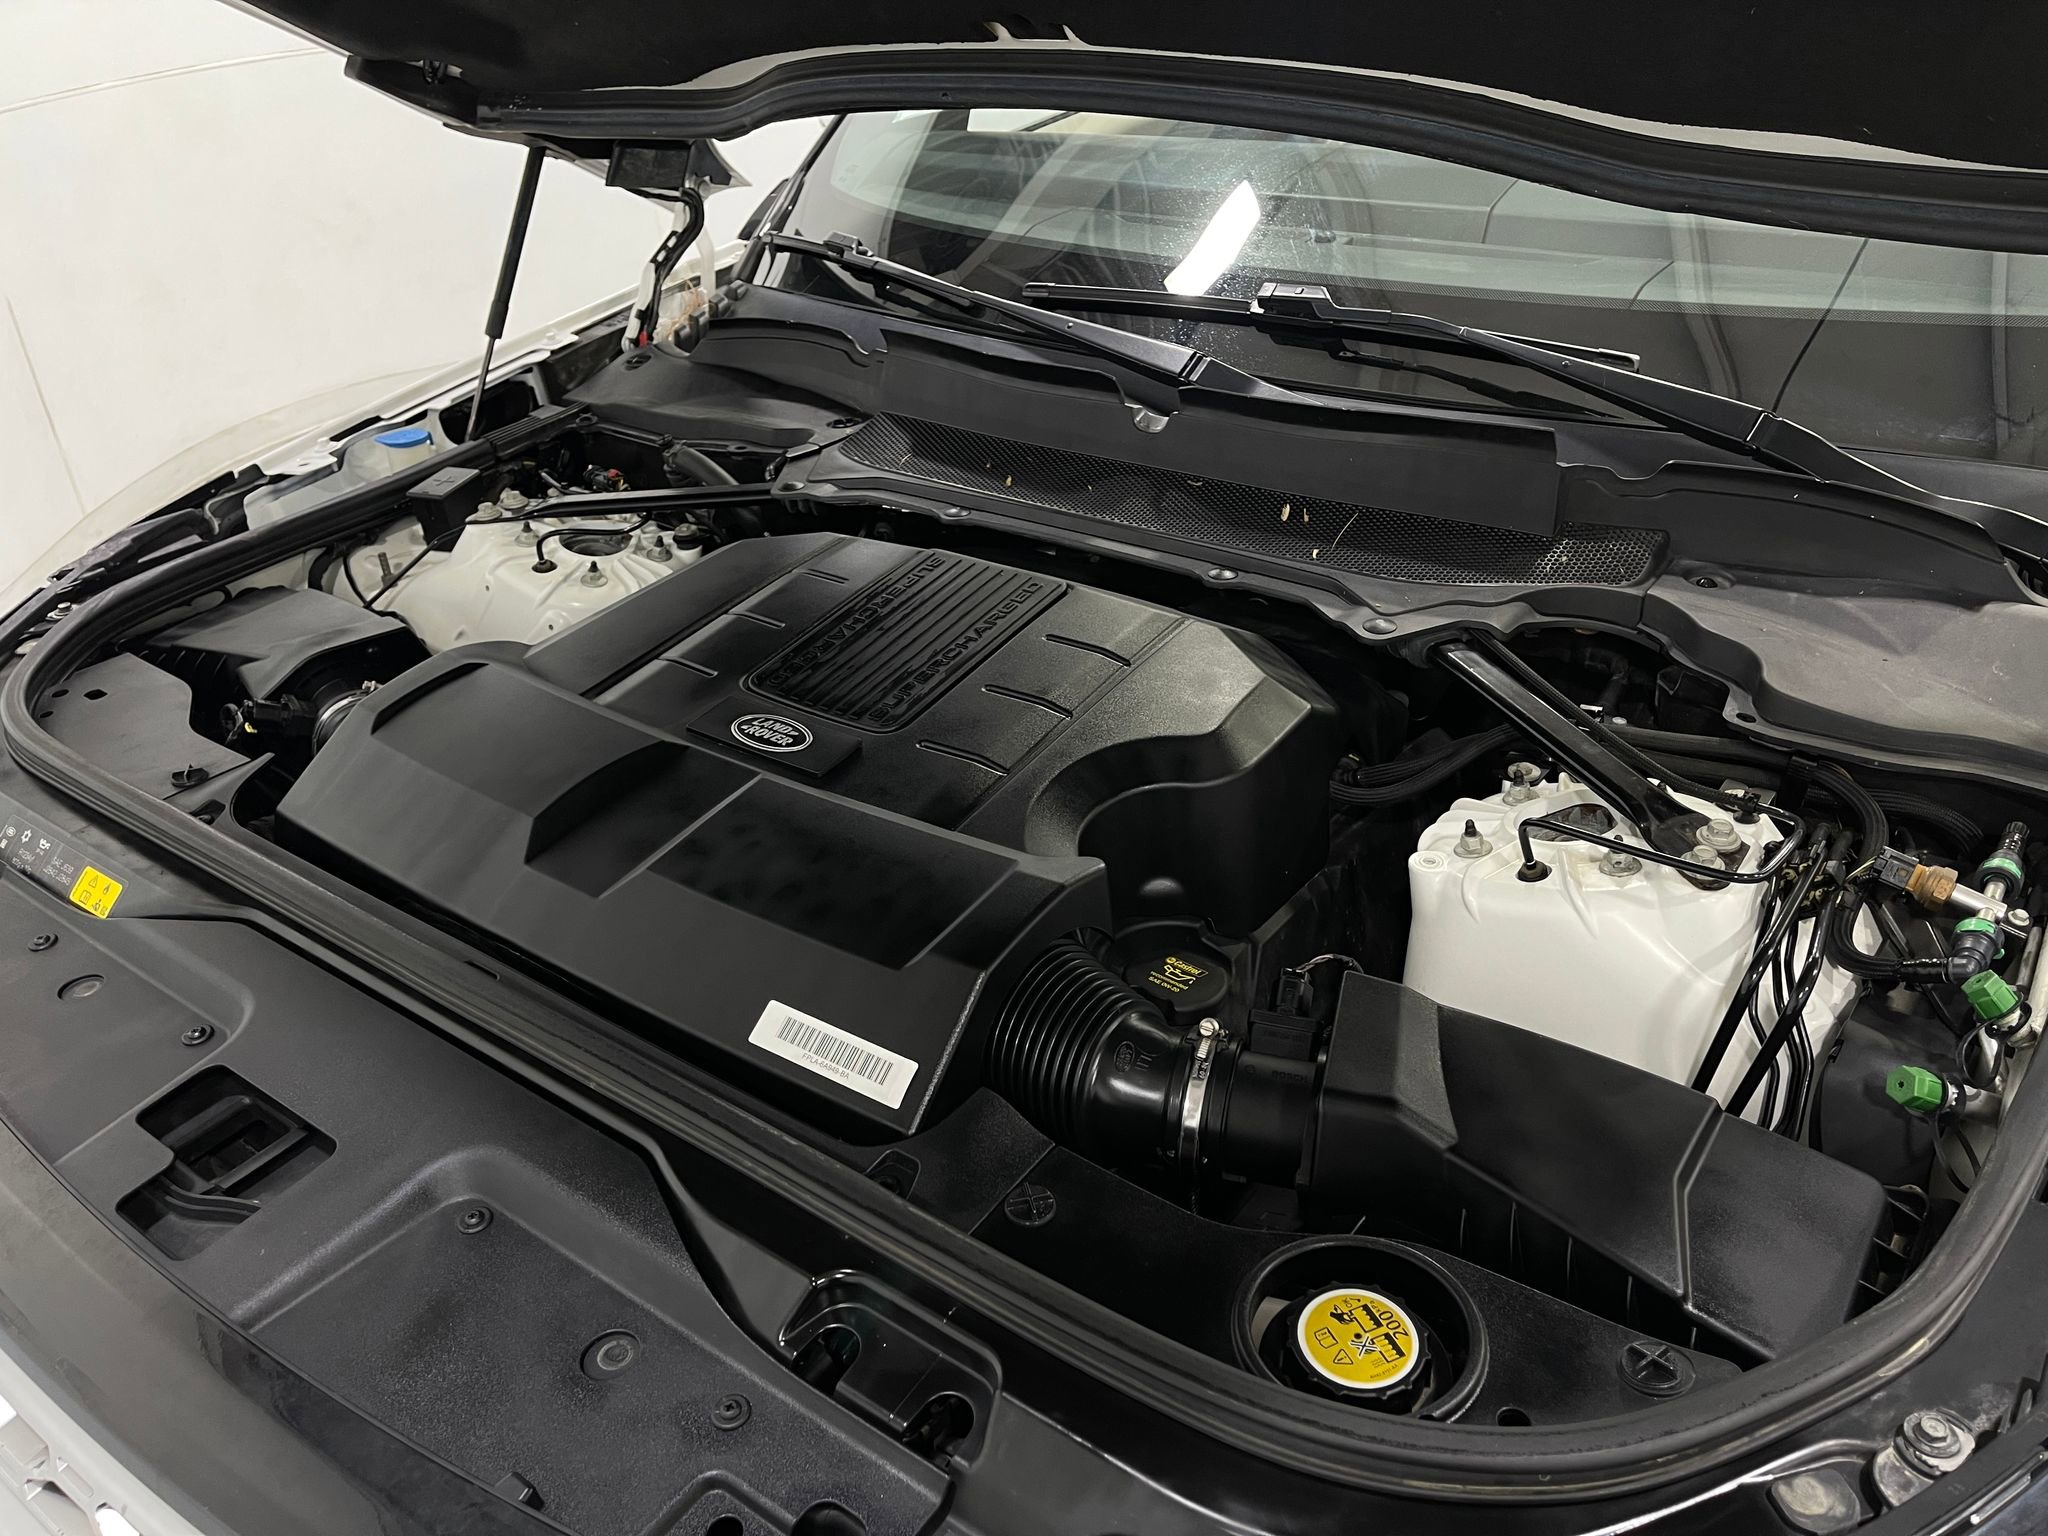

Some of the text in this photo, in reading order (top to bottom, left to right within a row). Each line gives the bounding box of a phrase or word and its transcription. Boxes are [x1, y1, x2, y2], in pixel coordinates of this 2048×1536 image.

[867, 581, 1045, 722] SUPERCHARGED
[744, 726, 794, 746] ROVER
[751, 718, 793, 734] LAND
[1173, 960, 1203, 976] Castrol
[1379, 1310, 1409, 1340] 200
